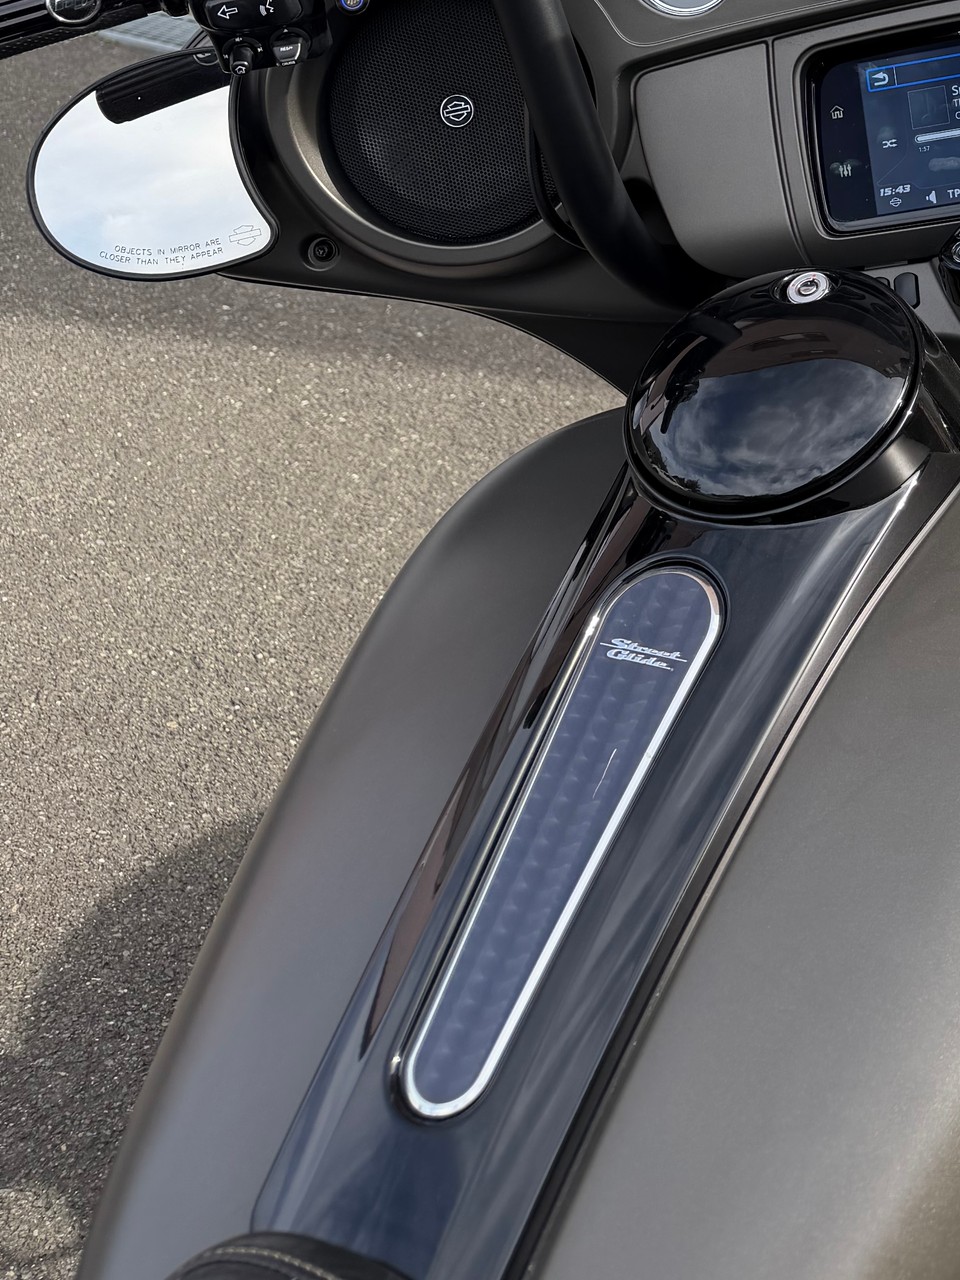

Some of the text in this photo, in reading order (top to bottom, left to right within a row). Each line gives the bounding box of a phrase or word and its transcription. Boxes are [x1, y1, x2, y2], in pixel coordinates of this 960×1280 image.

[918, 145, 930, 153] 1:57
[879, 184, 911, 197] 15:43
[947, 188, 960, 199] TP
[114, 237, 222, 256] OBJECTS IN MIRROR ARE
[99, 247, 224, 265] CLOSER THAN THEY APPEAR
[611, 638, 681, 659] Street
[606, 649, 672, 669] Glide
